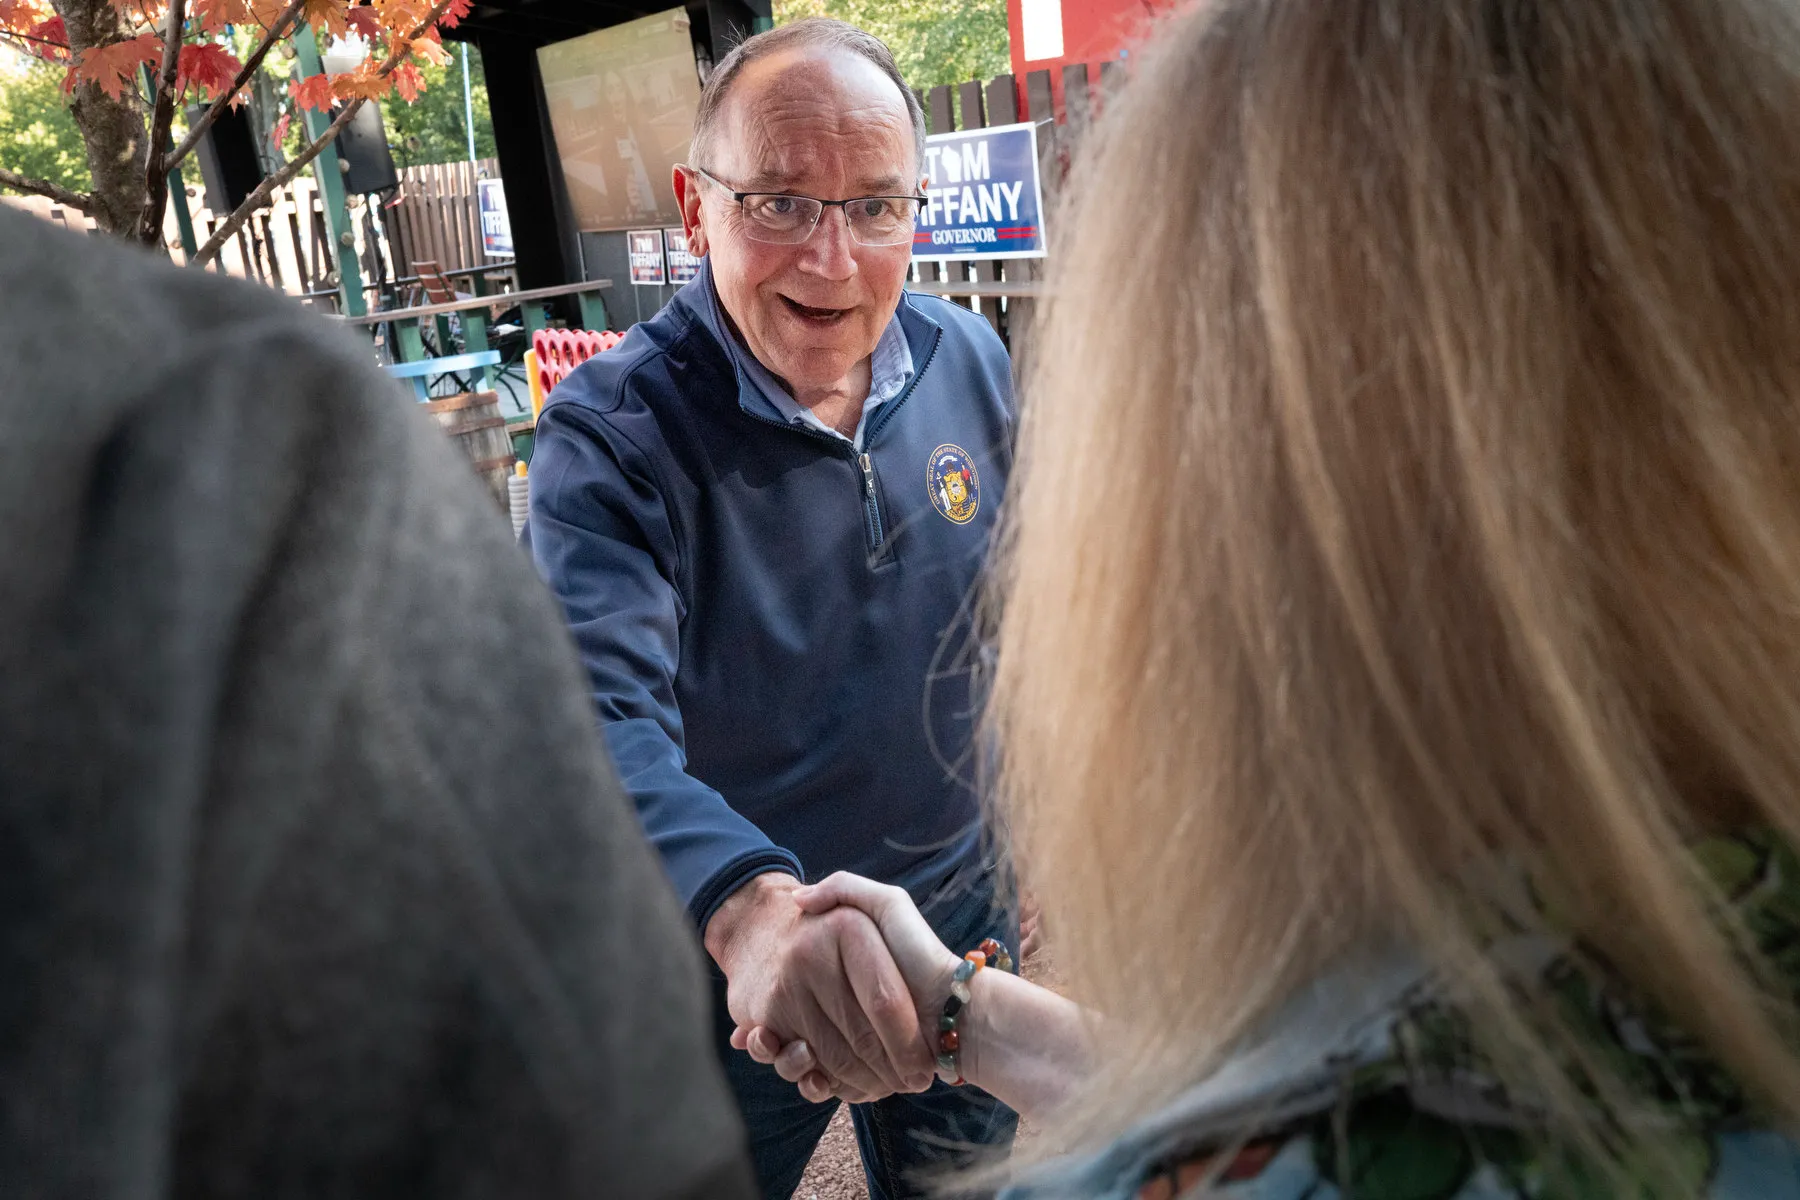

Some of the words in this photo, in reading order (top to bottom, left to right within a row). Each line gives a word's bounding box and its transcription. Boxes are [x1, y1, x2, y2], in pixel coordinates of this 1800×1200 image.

[925, 140, 991, 184] TOM
[918, 180, 1023, 226] IFFANY
[931, 227, 997, 245] GOVERNOR
